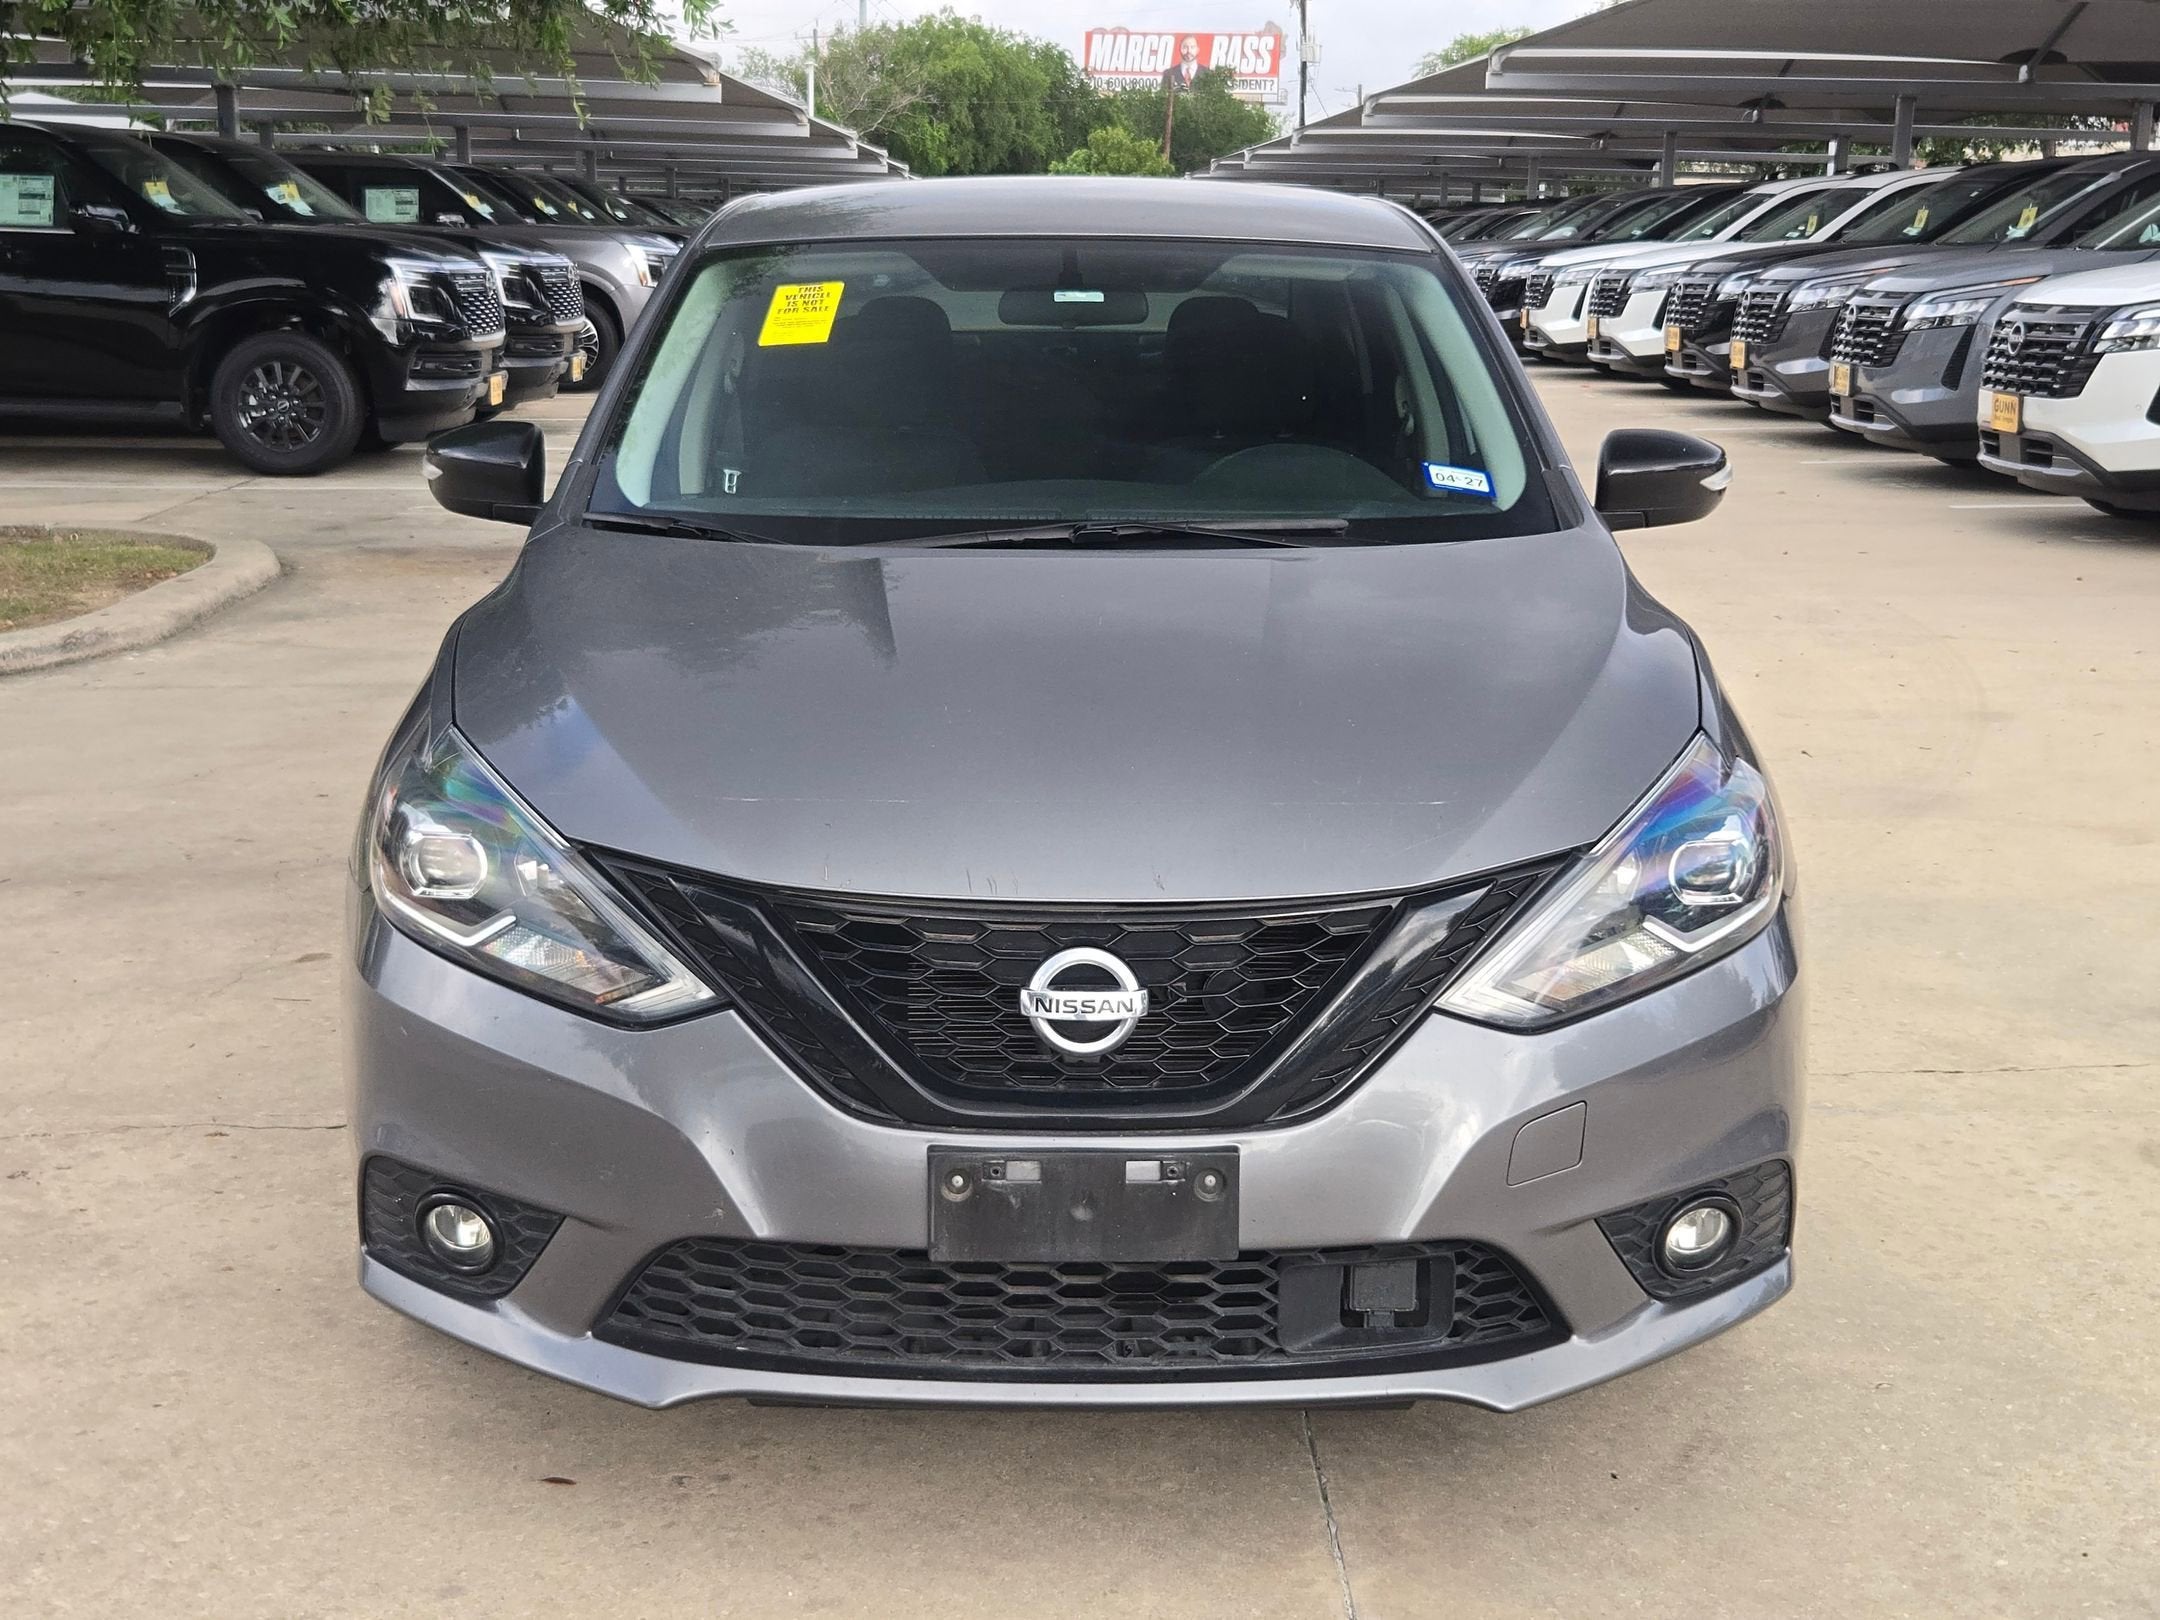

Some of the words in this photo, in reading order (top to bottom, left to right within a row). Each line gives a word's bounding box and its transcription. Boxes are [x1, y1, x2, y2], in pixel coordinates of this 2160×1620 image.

[1088, 34, 1175, 73] MARCO
[802, 299, 824, 307] NOT
[802, 305, 829, 313] SALE
[1994, 398, 2017, 416] GUNN
[1034, 997, 1134, 1014] NISSAN
